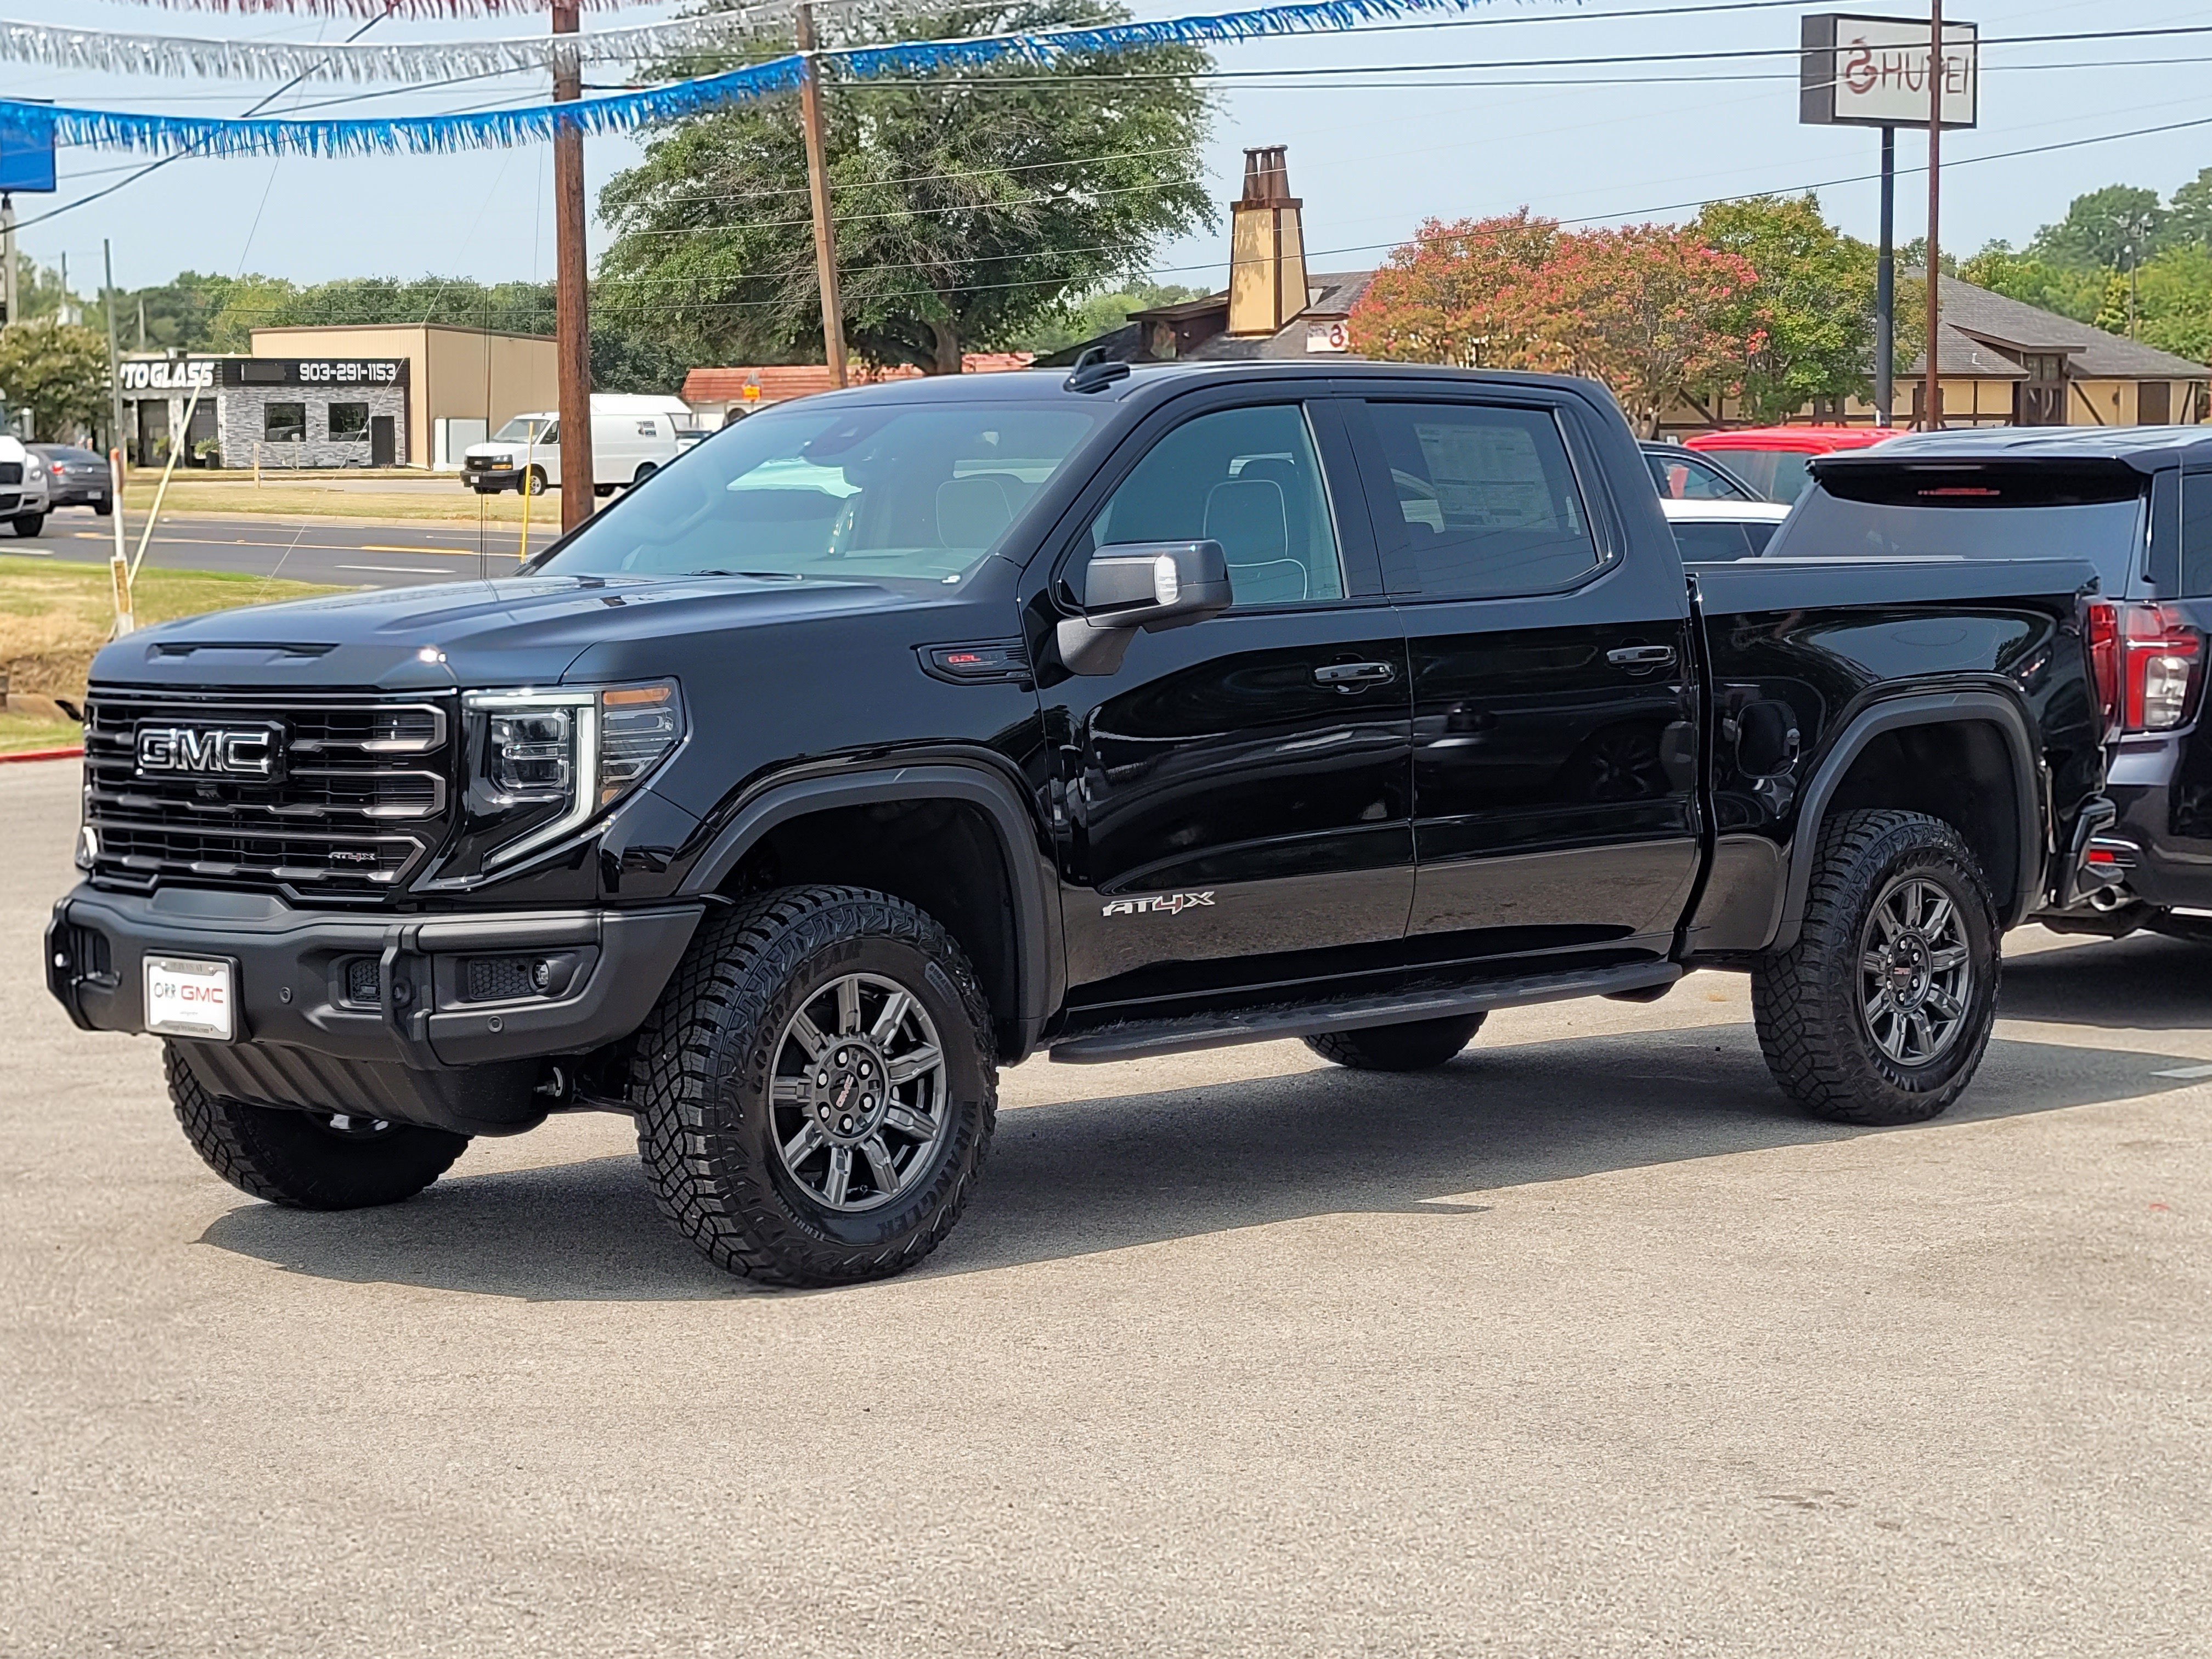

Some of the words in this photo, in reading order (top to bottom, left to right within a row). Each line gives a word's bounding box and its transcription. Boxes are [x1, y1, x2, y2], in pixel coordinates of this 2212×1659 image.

[300, 363, 396, 381] 903-291-1153
[138, 728, 269, 774] GMC
[328, 851, 375, 862] AT4X
[1102, 891, 1216, 917] AT4X
[180, 985, 223, 1003] GMC
